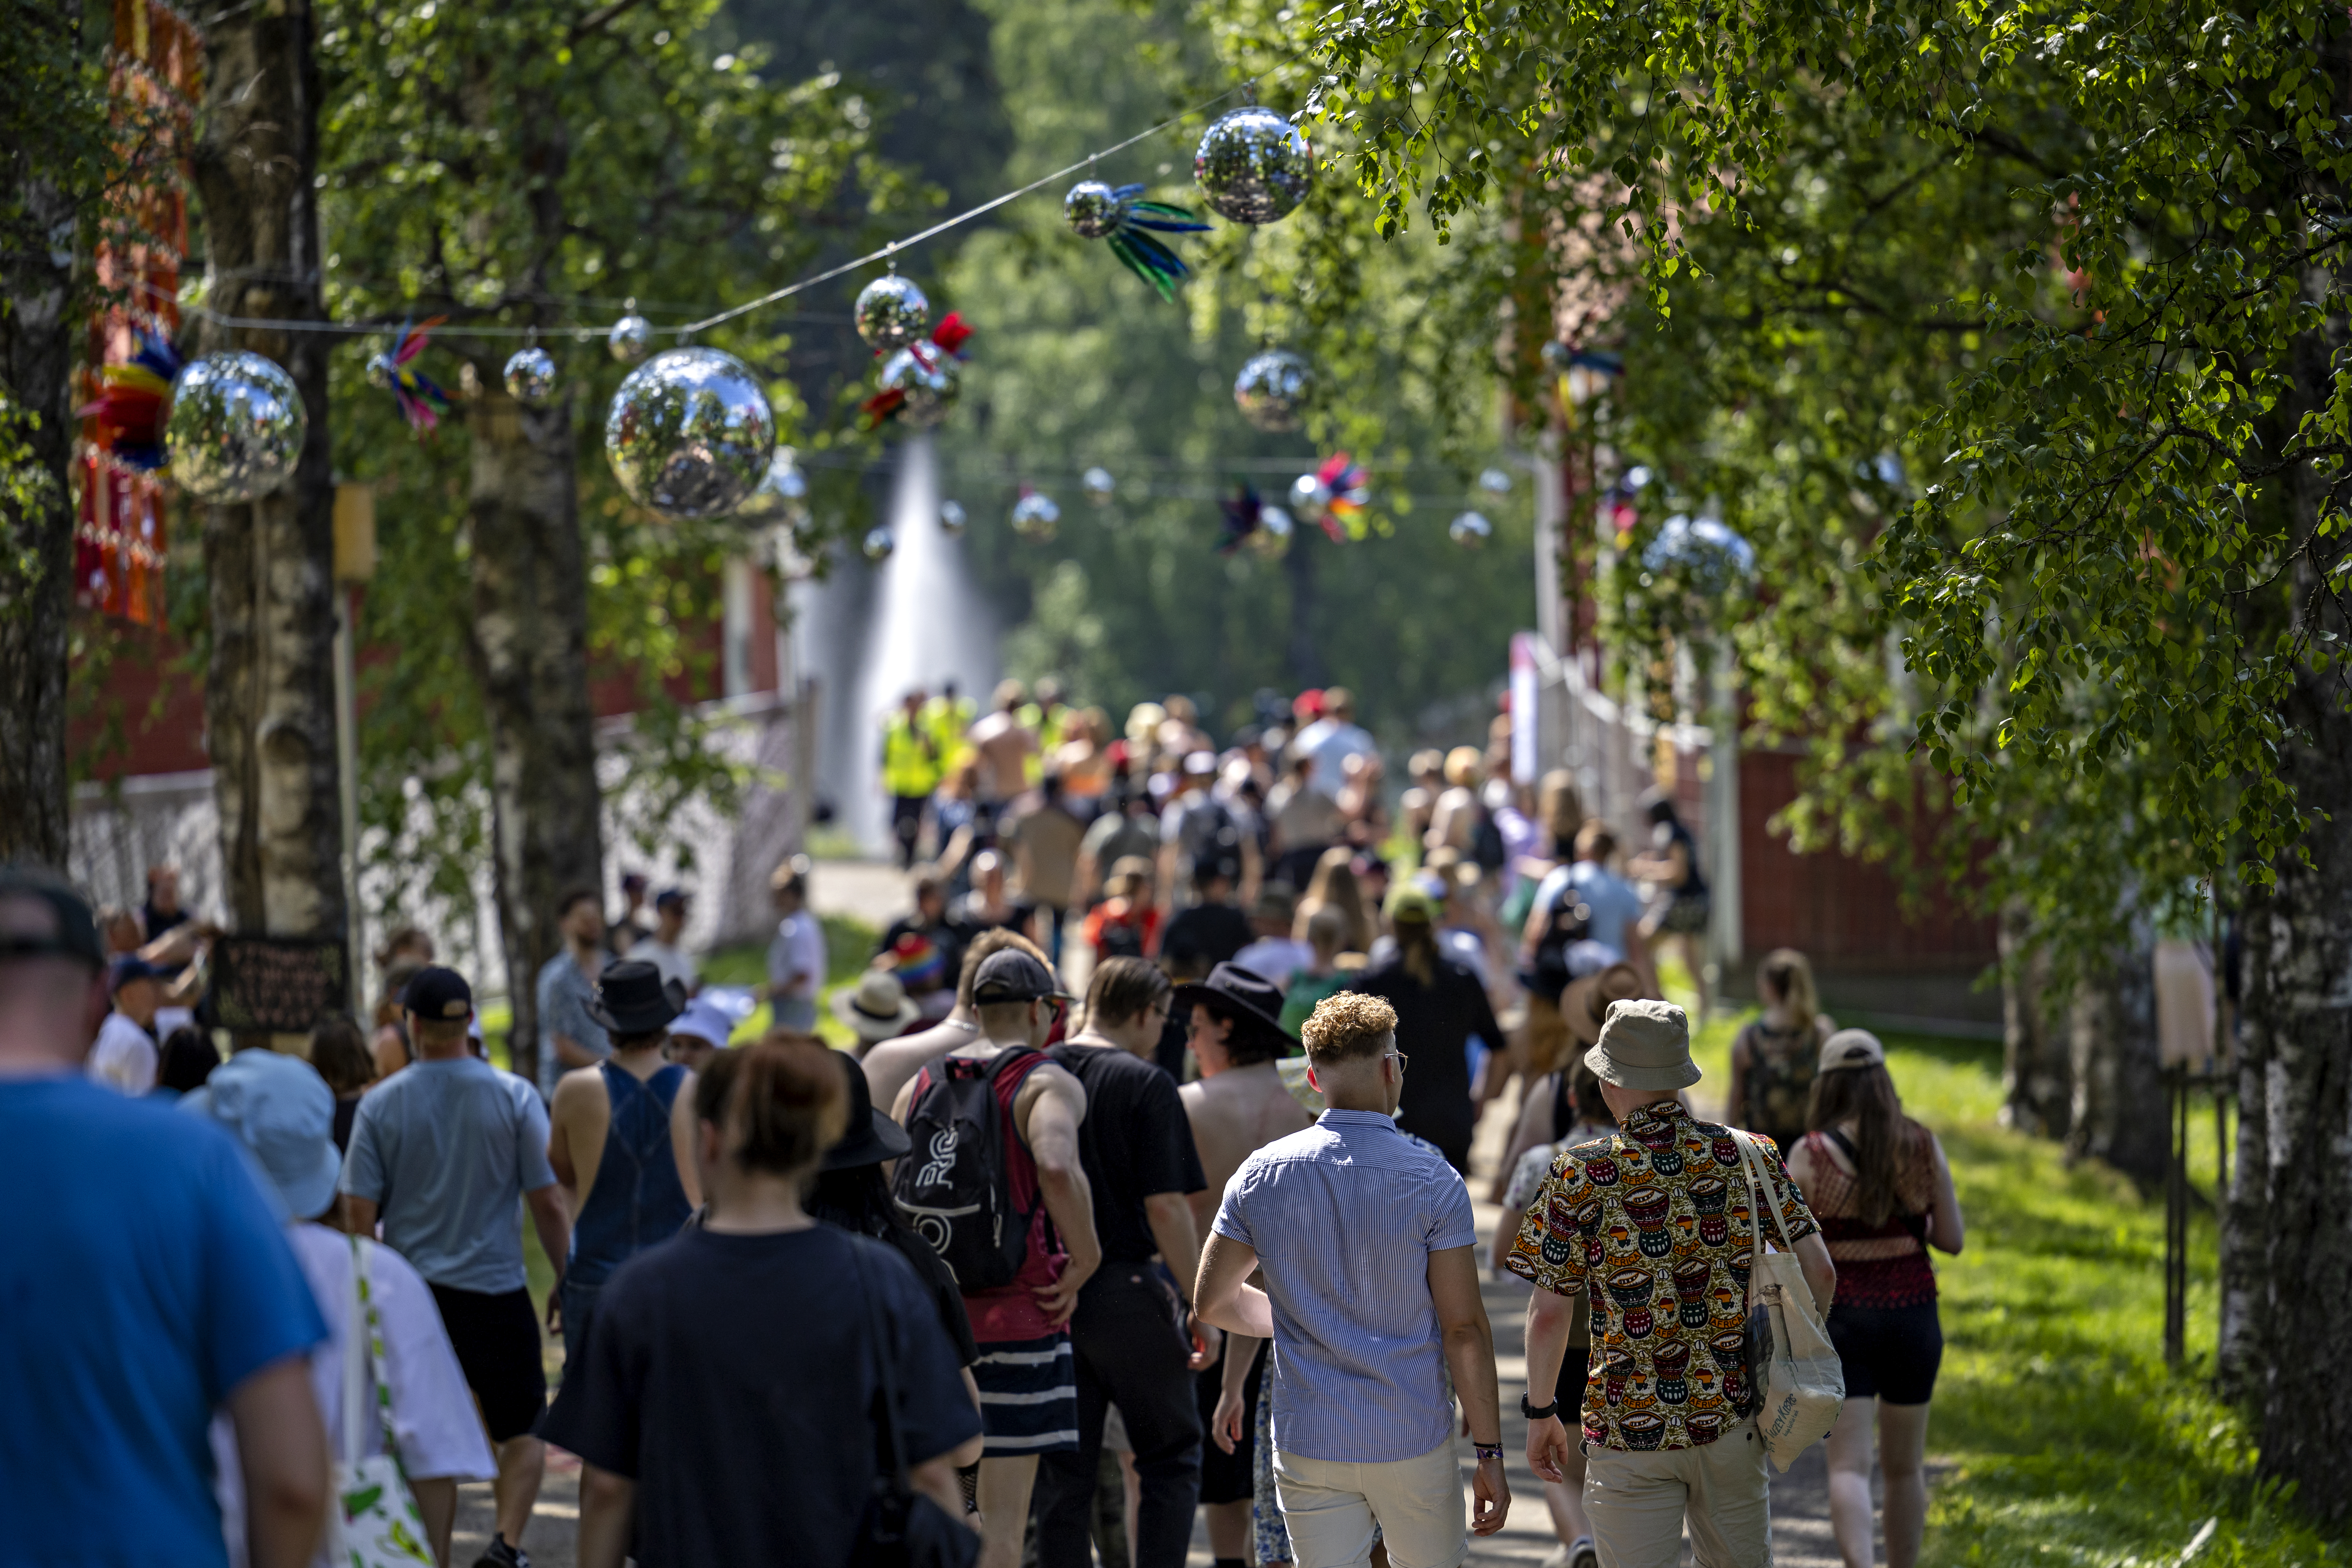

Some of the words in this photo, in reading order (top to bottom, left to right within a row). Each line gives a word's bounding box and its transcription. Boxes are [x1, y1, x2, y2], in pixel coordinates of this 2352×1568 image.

[1686, 1161, 1715, 1172] AFRICA
[1622, 1172, 1655, 1184] AFRICA
[1572, 1185, 1593, 1203] FRICA
[1516, 1238, 1540, 1254] AFRICA
[1729, 1237, 1753, 1245] AFRIC
[1673, 1243, 1700, 1255] AFRICA
[1608, 1254, 1641, 1265] AFRICA
[1566, 1263, 1586, 1275] AFRI
[1711, 1316, 1743, 1328] AFRICA
[1655, 1325, 1680, 1338] AFRICA
[1624, 1397, 1655, 1408] AFRICA
[1690, 1397, 1722, 1408] AFRICA
